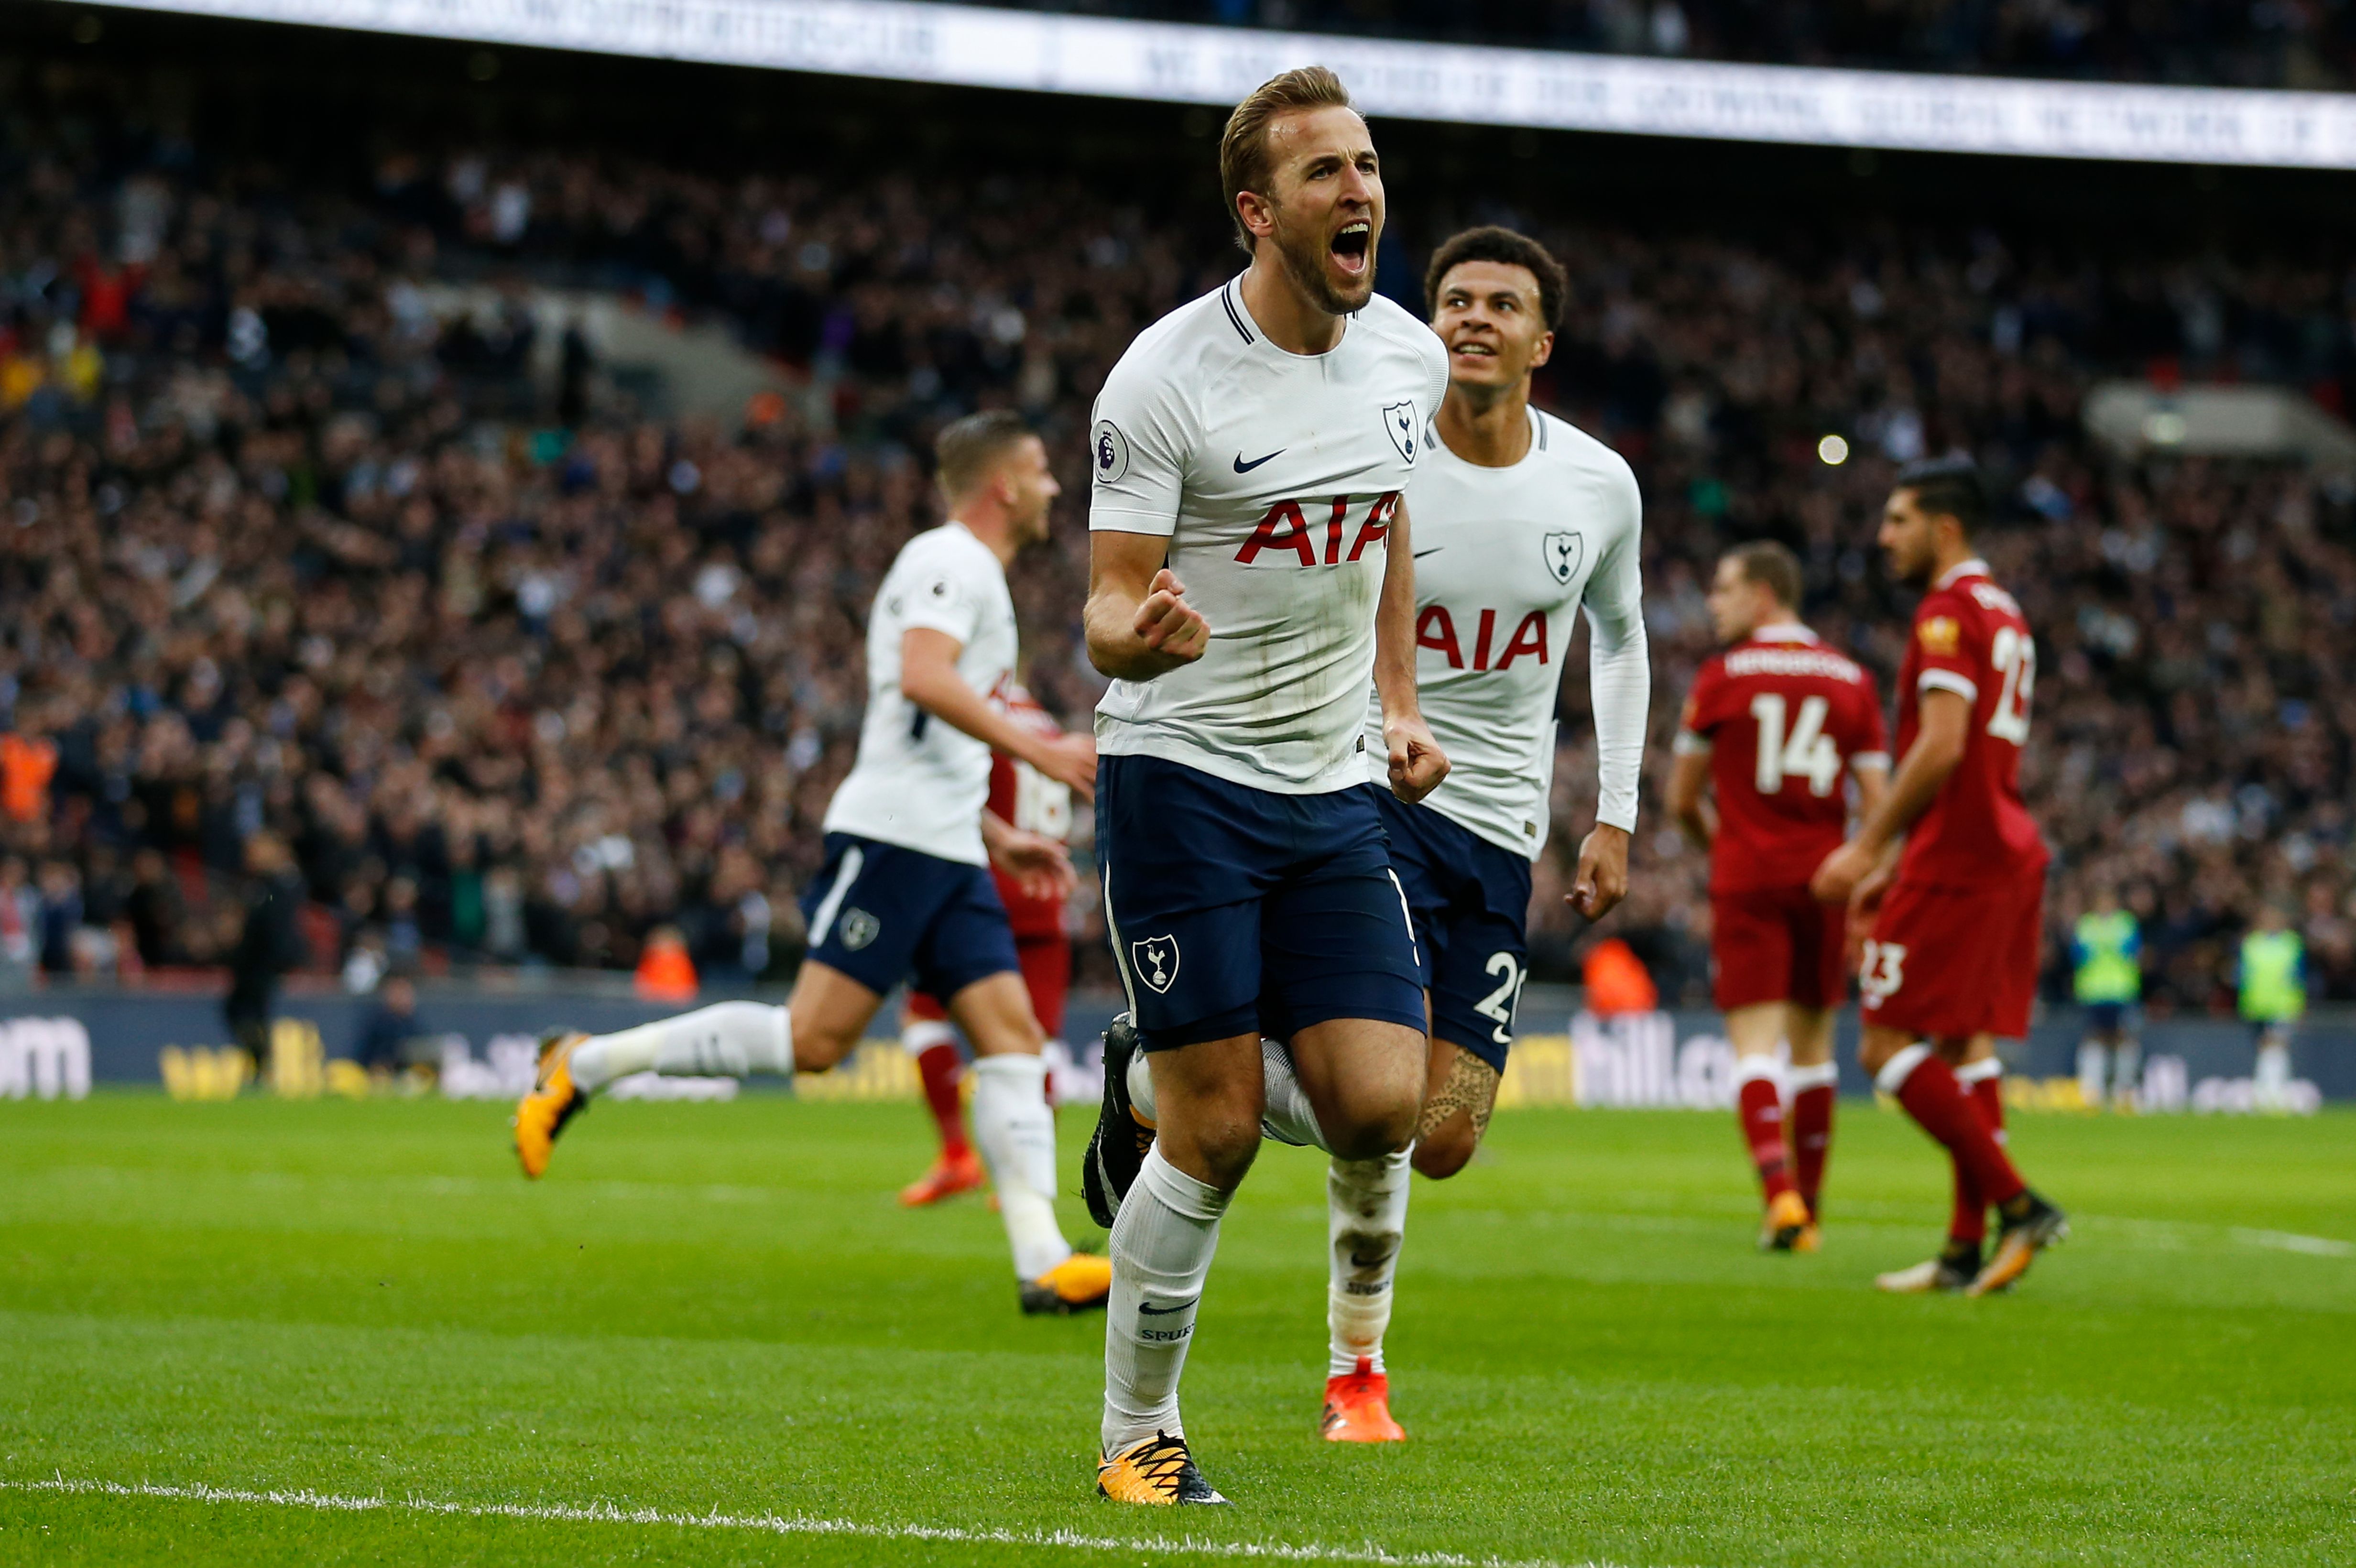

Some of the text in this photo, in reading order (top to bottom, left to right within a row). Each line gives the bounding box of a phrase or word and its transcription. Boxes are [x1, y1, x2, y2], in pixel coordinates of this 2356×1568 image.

[1233, 491, 1398, 567] AIA
[1416, 605, 1549, 671] AIA
[1749, 692, 1843, 797] 14
[1473, 951, 1528, 1028] 2
[0, 1014, 92, 1101] m
[1142, 1323, 1195, 1341] SPUR
